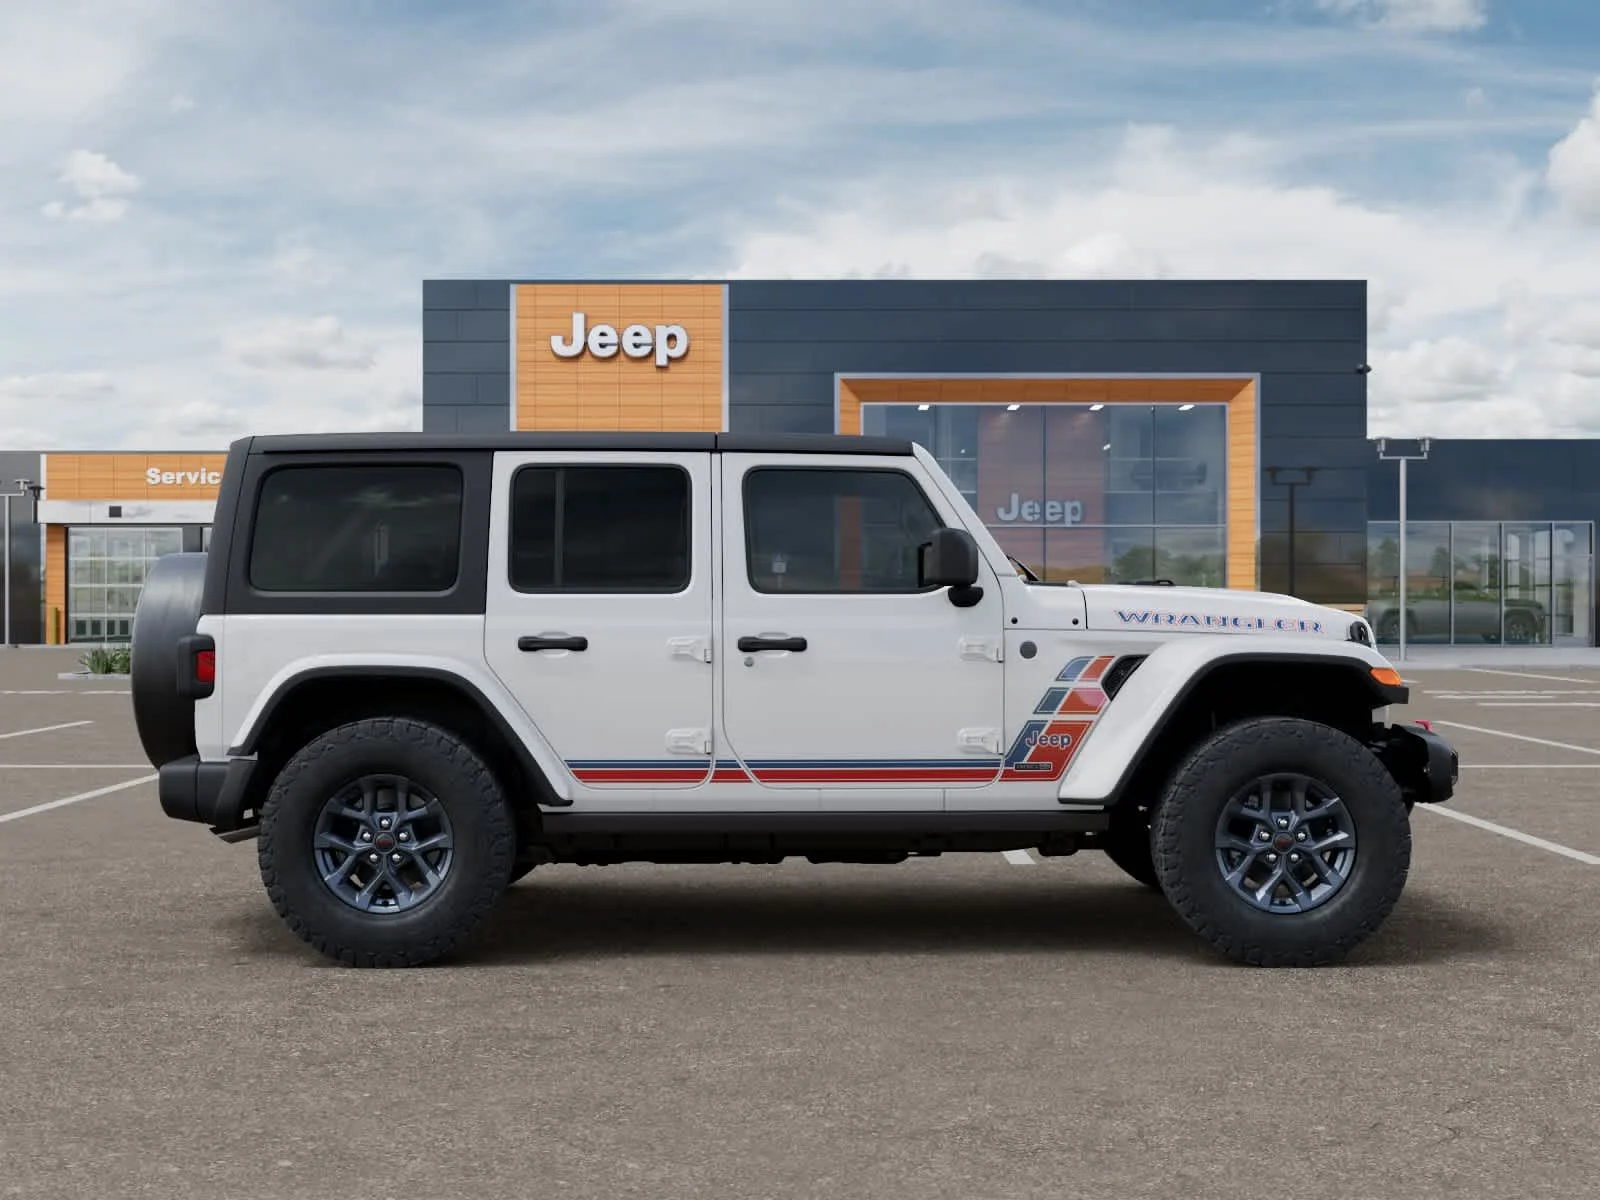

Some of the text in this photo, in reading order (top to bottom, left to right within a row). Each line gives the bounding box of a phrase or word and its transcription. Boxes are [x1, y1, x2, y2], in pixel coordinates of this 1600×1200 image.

[550, 312, 690, 368] Jeep
[146, 467, 222, 485] Servic
[996, 492, 1082, 527] Jeep
[1115, 609, 1325, 633] WRANGLER
[1025, 730, 1072, 750] Jeep
